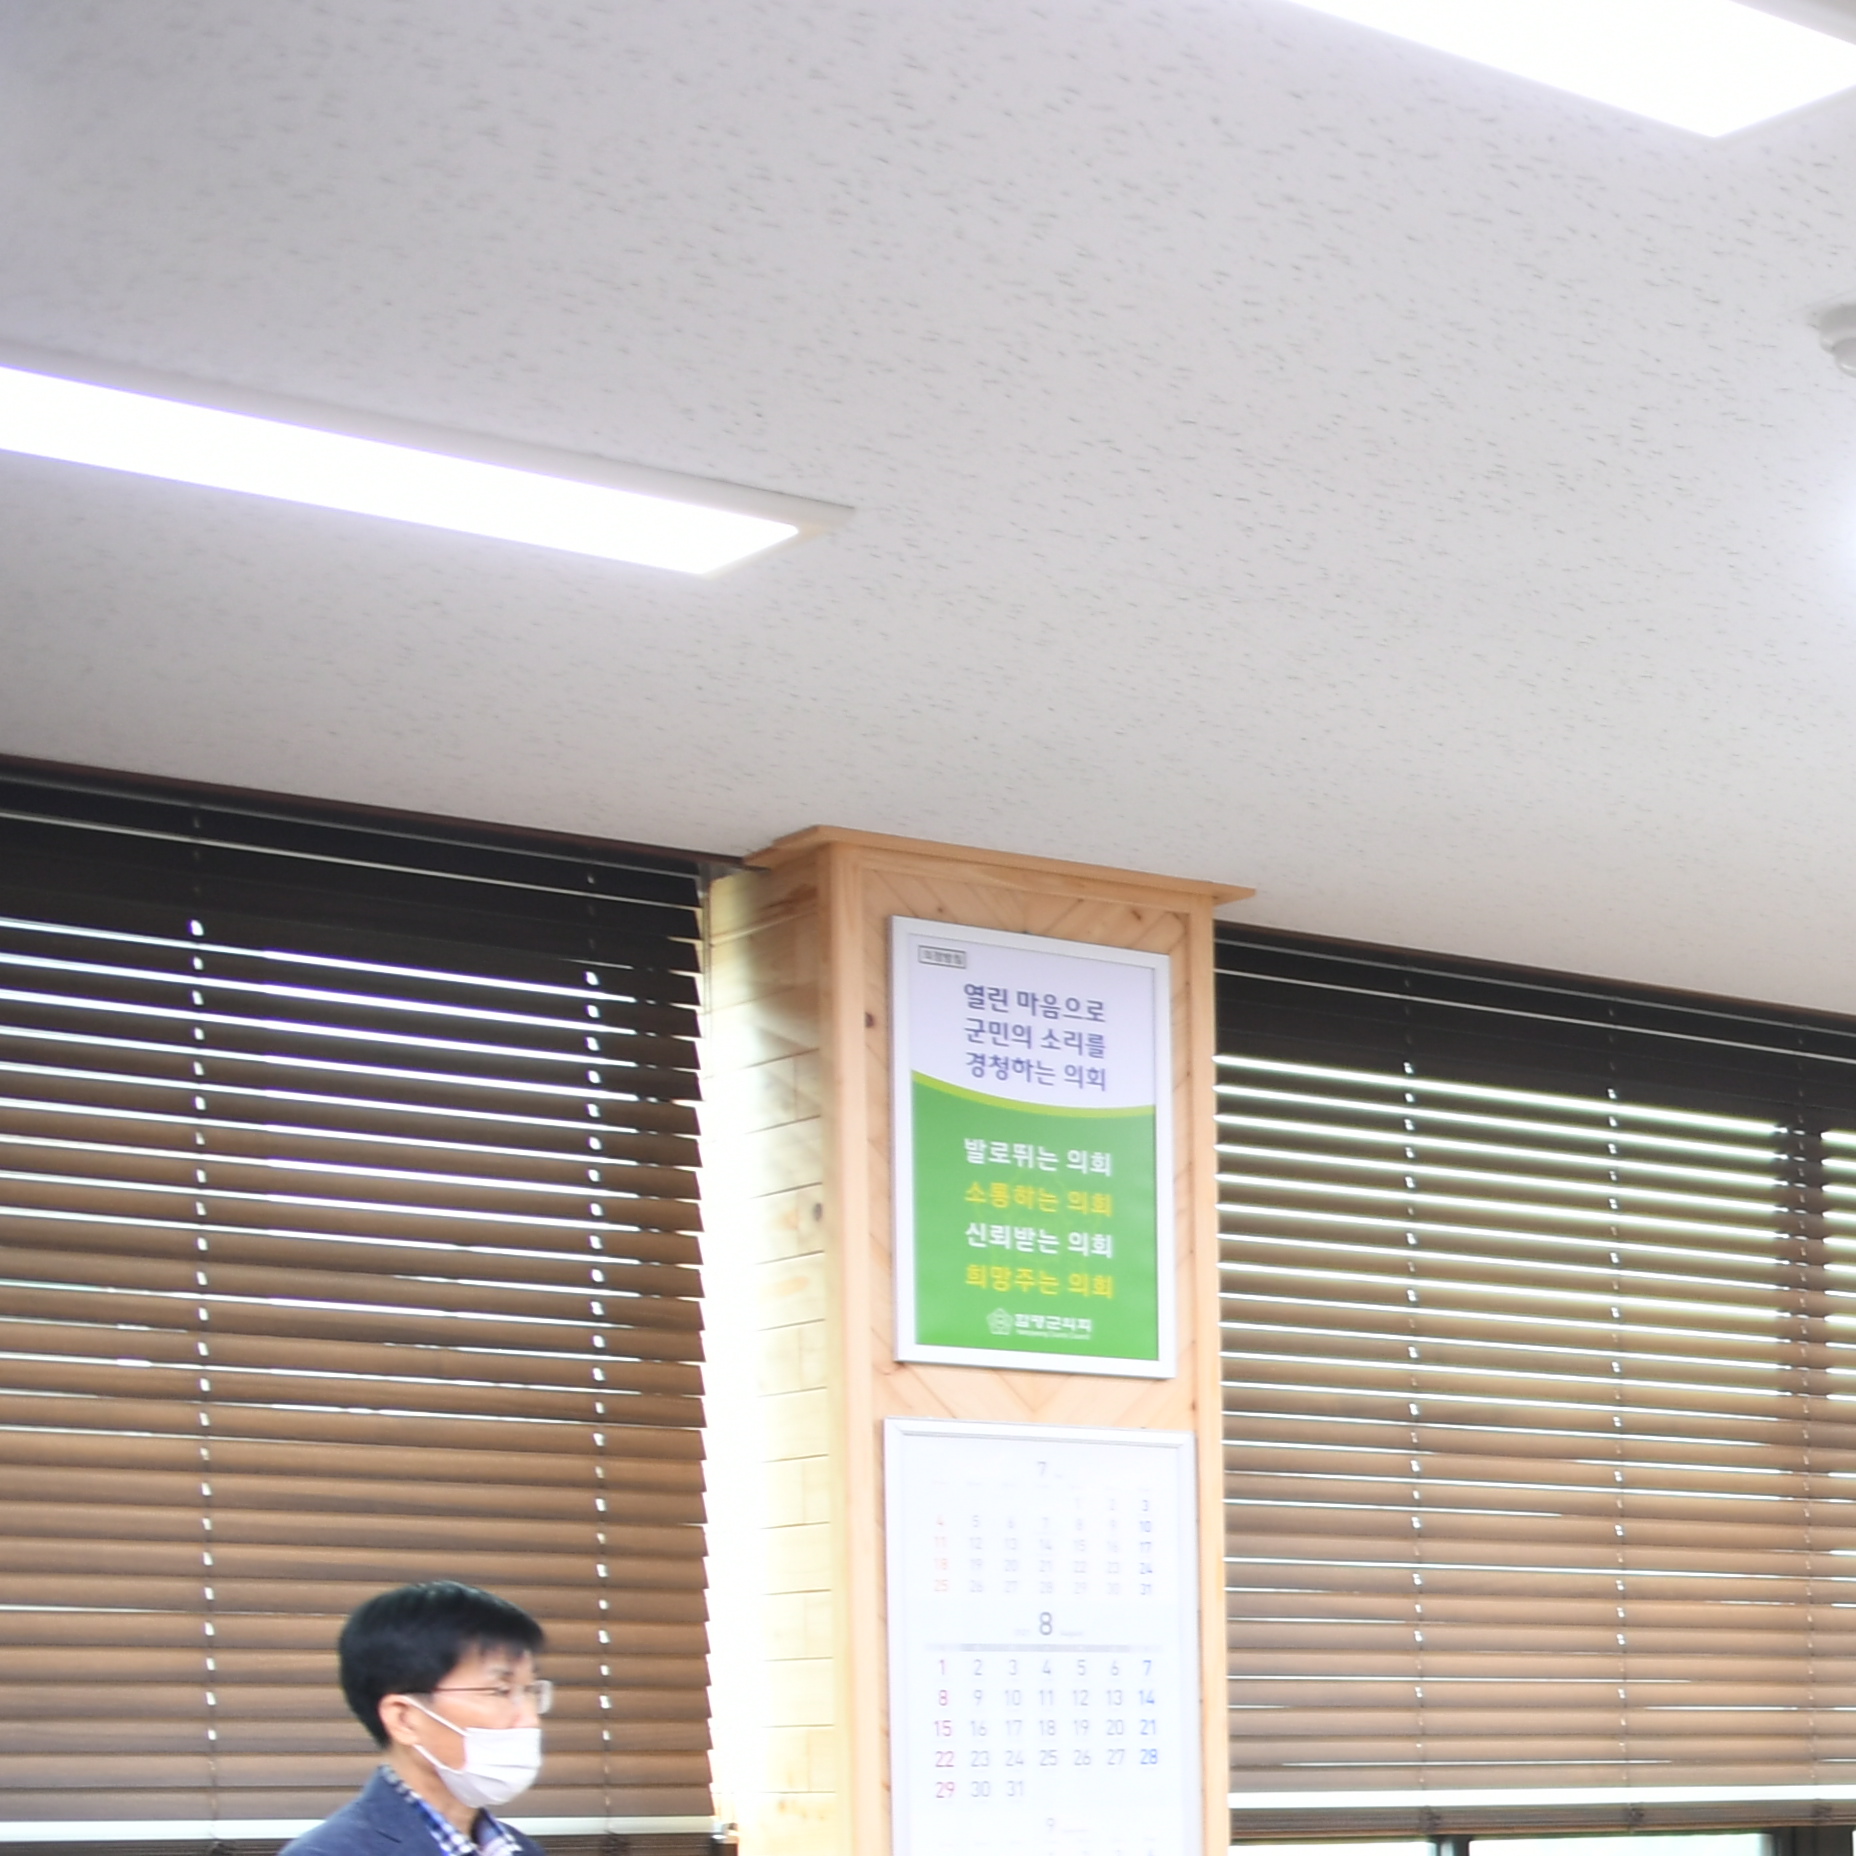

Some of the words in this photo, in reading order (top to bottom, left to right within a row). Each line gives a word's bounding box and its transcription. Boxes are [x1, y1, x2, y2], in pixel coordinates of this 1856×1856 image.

[963, 983, 1009, 1013] 열린
[1016, 991, 1106, 1022] 마음으로
[964, 1017, 1032, 1049] 군민의
[1040, 1028, 1106, 1059] 소리를
[965, 1052, 1056, 1086] 경청하는
[1063, 1064, 1106, 1091] 의회
[964, 1138, 1059, 1171] 발로뛰는
[1067, 1149, 1112, 1177] 의회
[964, 1182, 1060, 1212] 소통하는
[1067, 1191, 1112, 1217] 의회
[965, 1223, 1060, 1254] 신뢰받는
[1067, 1232, 1113, 1258] 의회
[965, 1264, 1060, 1295] 희망주는
[1067, 1273, 1113, 1299] 의회
[1037, 1461, 1048, 1476] 7
[1140, 1541, 1151, 1553] 17
[934, 1579, 948, 1592] 25
[1039, 1612, 1052, 1635] 8
[939, 1659, 945, 1675] 1
[974, 1659, 982, 1676] 2
[1009, 1659, 1017, 1675] 3
[1042, 1659, 1051, 1675] 4
[1077, 1659, 1086, 1676] 5
[1111, 1660, 1119, 1676] 6
[1143, 1660, 1152, 1675] 7
[939, 1690, 947, 1706] 8
[974, 1690, 982, 1706] 9
[1005, 1690, 1021, 1706] 10
[1039, 1690, 1053, 1705] 11
[1073, 1689, 1088, 1706] 12
[1106, 1689, 1123, 1706] 13
[1139, 1690, 1155, 1705] 14
[933, 1720, 952, 1737] 15
[970, 1720, 986, 1736] 16
[1006, 1719, 1023, 1736] 17
[1039, 1720, 1055, 1736] 18
[1074, 1719, 1089, 1735] 19
[1106, 1719, 1124, 1735] 20
[1140, 1719, 1155, 1735] 21
[935, 1751, 954, 1767] 22
[971, 1751, 989, 1767] 23
[1006, 1750, 1024, 1766] 24
[1040, 1750, 1057, 1766] 25
[1074, 1749, 1091, 1766] 26
[1107, 1749, 1125, 1765] 27
[1140, 1749, 1157, 1764] 28
[936, 1782, 955, 1798] 29
[971, 1781, 990, 1797] 30
[1008, 1780, 1023, 1797] 31
